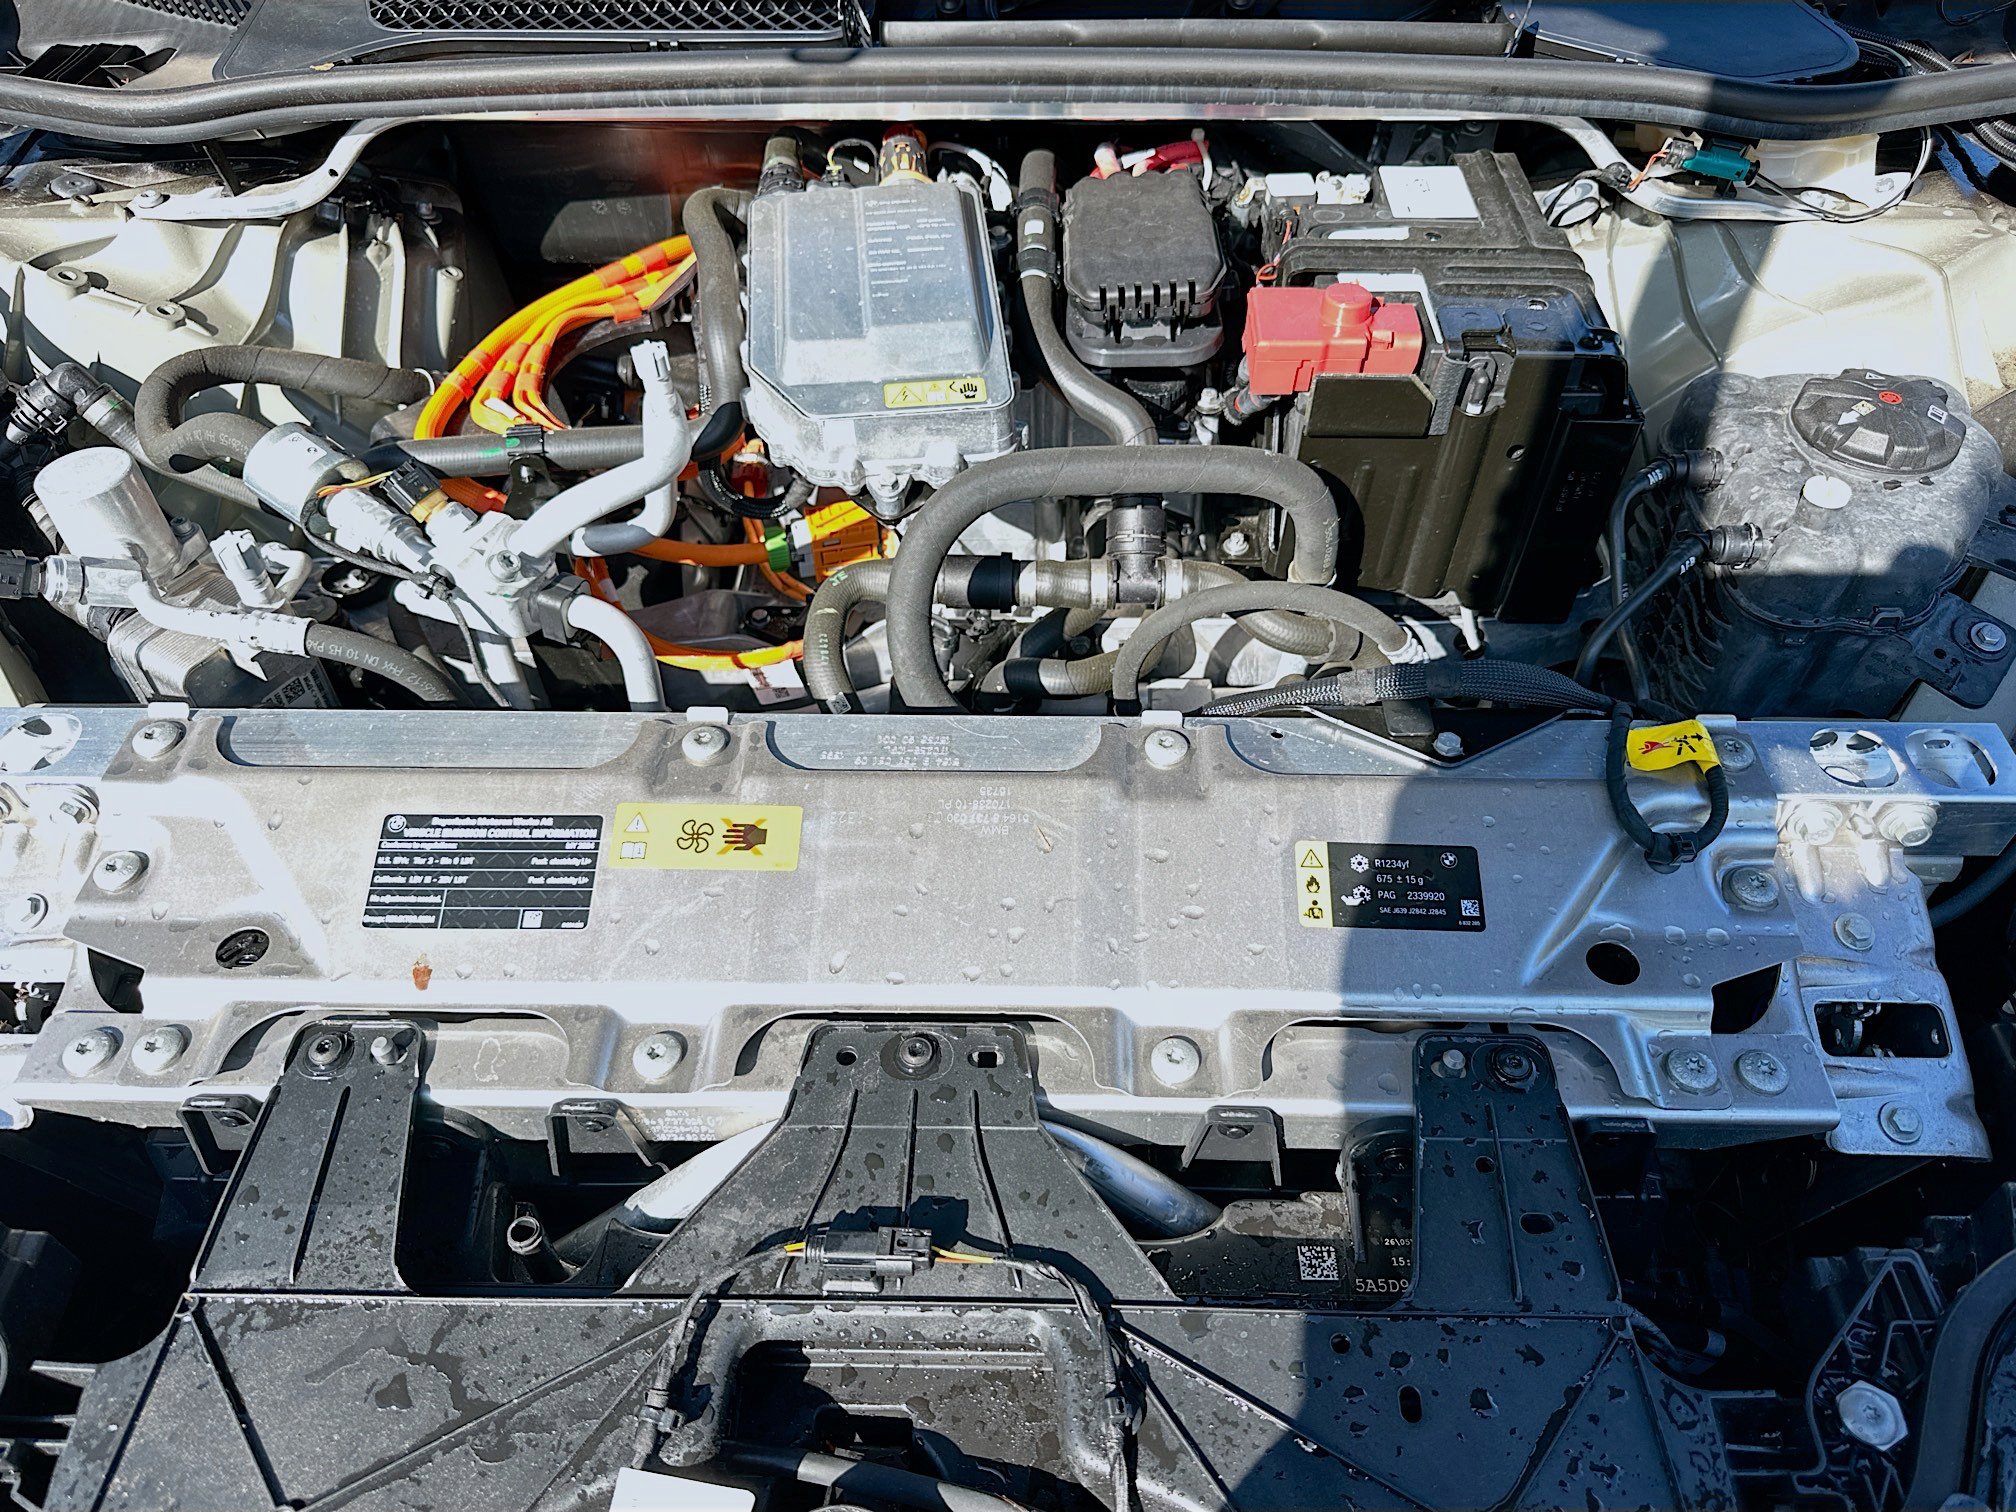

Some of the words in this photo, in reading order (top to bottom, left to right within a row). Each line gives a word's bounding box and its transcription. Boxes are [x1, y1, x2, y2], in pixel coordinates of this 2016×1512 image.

[346, 648, 359, 660] 10
[364, 654, 380, 667] DN
[383, 660, 404, 677] PHX
[980, 826, 1009, 835] BMW
[1375, 858, 1410, 869] R1234yf
[1376, 874, 1393, 883] 675
[1405, 875, 1417, 884] 15
[1418, 877, 1424, 885] g
[1377, 891, 1396, 899] PAG
[1407, 891, 1445, 901] 2339920
[1391, 1257, 1411, 1267] 15:
[1355, 1278, 1409, 1293] 5A5D9
